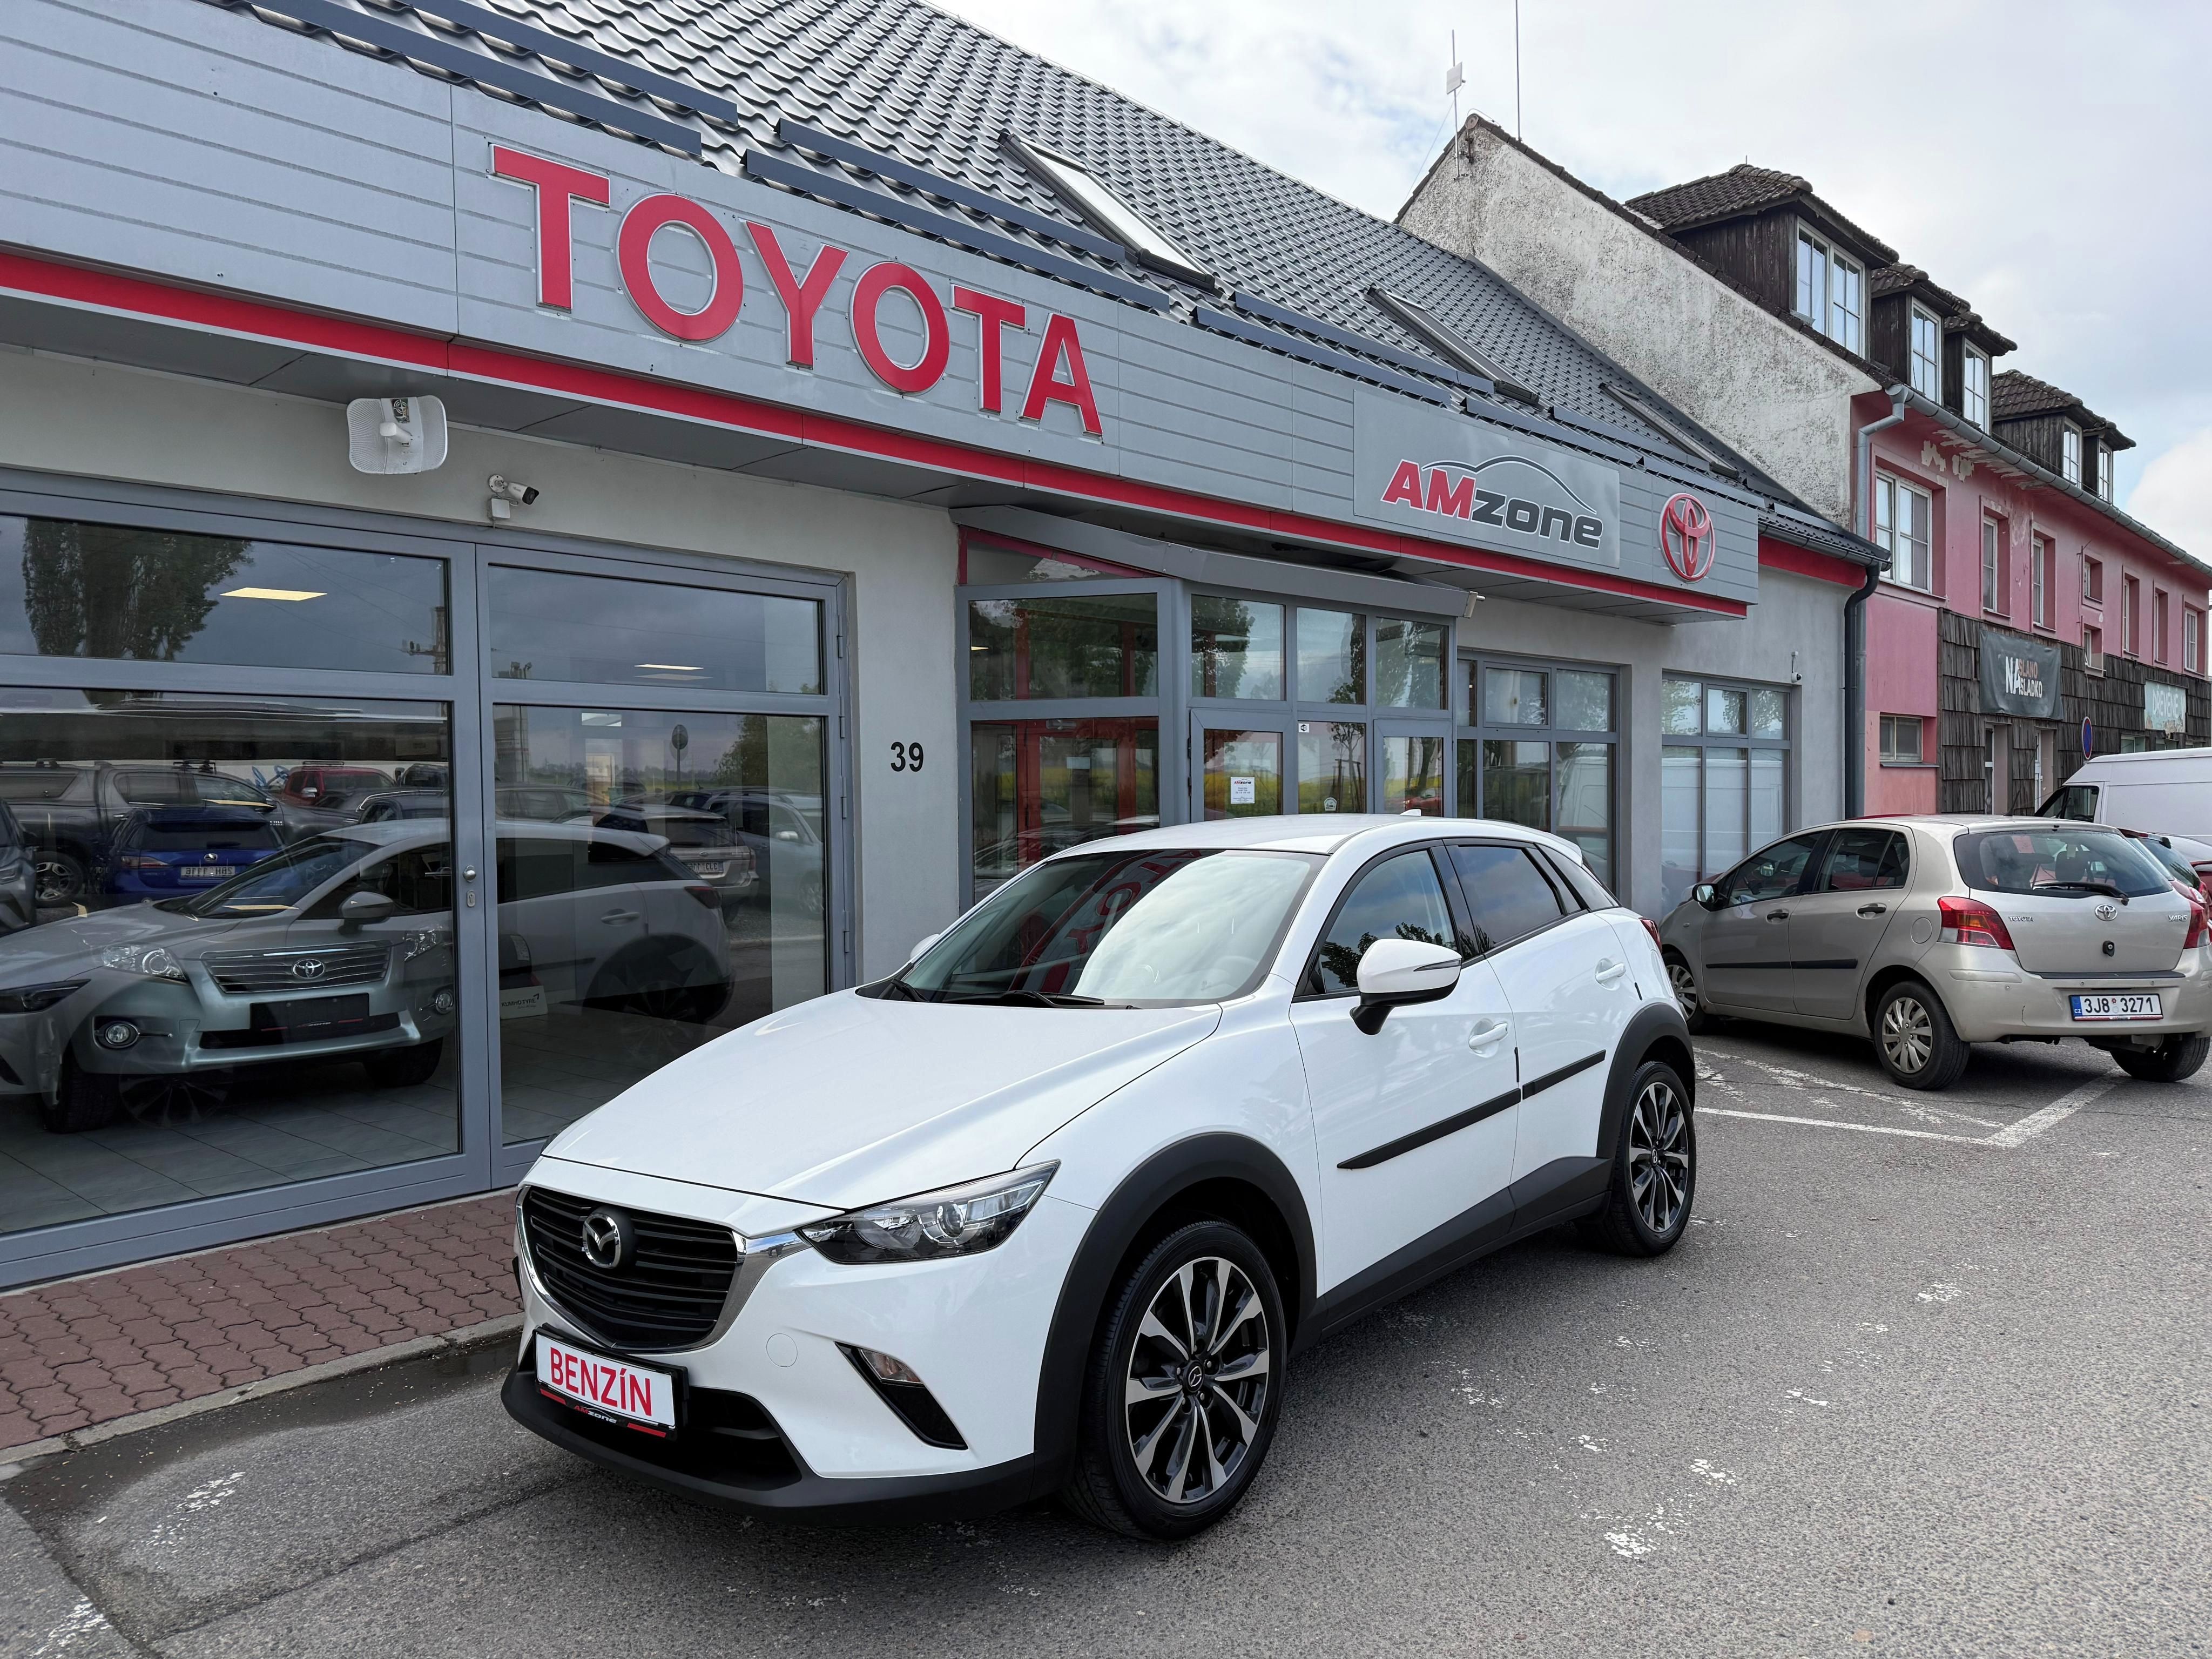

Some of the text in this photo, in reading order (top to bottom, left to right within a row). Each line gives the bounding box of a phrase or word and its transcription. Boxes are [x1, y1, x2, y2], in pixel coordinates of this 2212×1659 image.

[489, 144, 1103, 436] TOYOTA
[1380, 459, 1603, 549] AMzone
[2006, 656, 2021, 695] NA
[2019, 658, 2038, 679] SLANO
[2020, 678, 2042, 698] SLADKO
[891, 741, 923, 772] 39
[2084, 997, 2154, 1013] 3J8 3271
[550, 1347, 652, 1417] BENZÍN
[574, 1405, 617, 1424] AMzone
